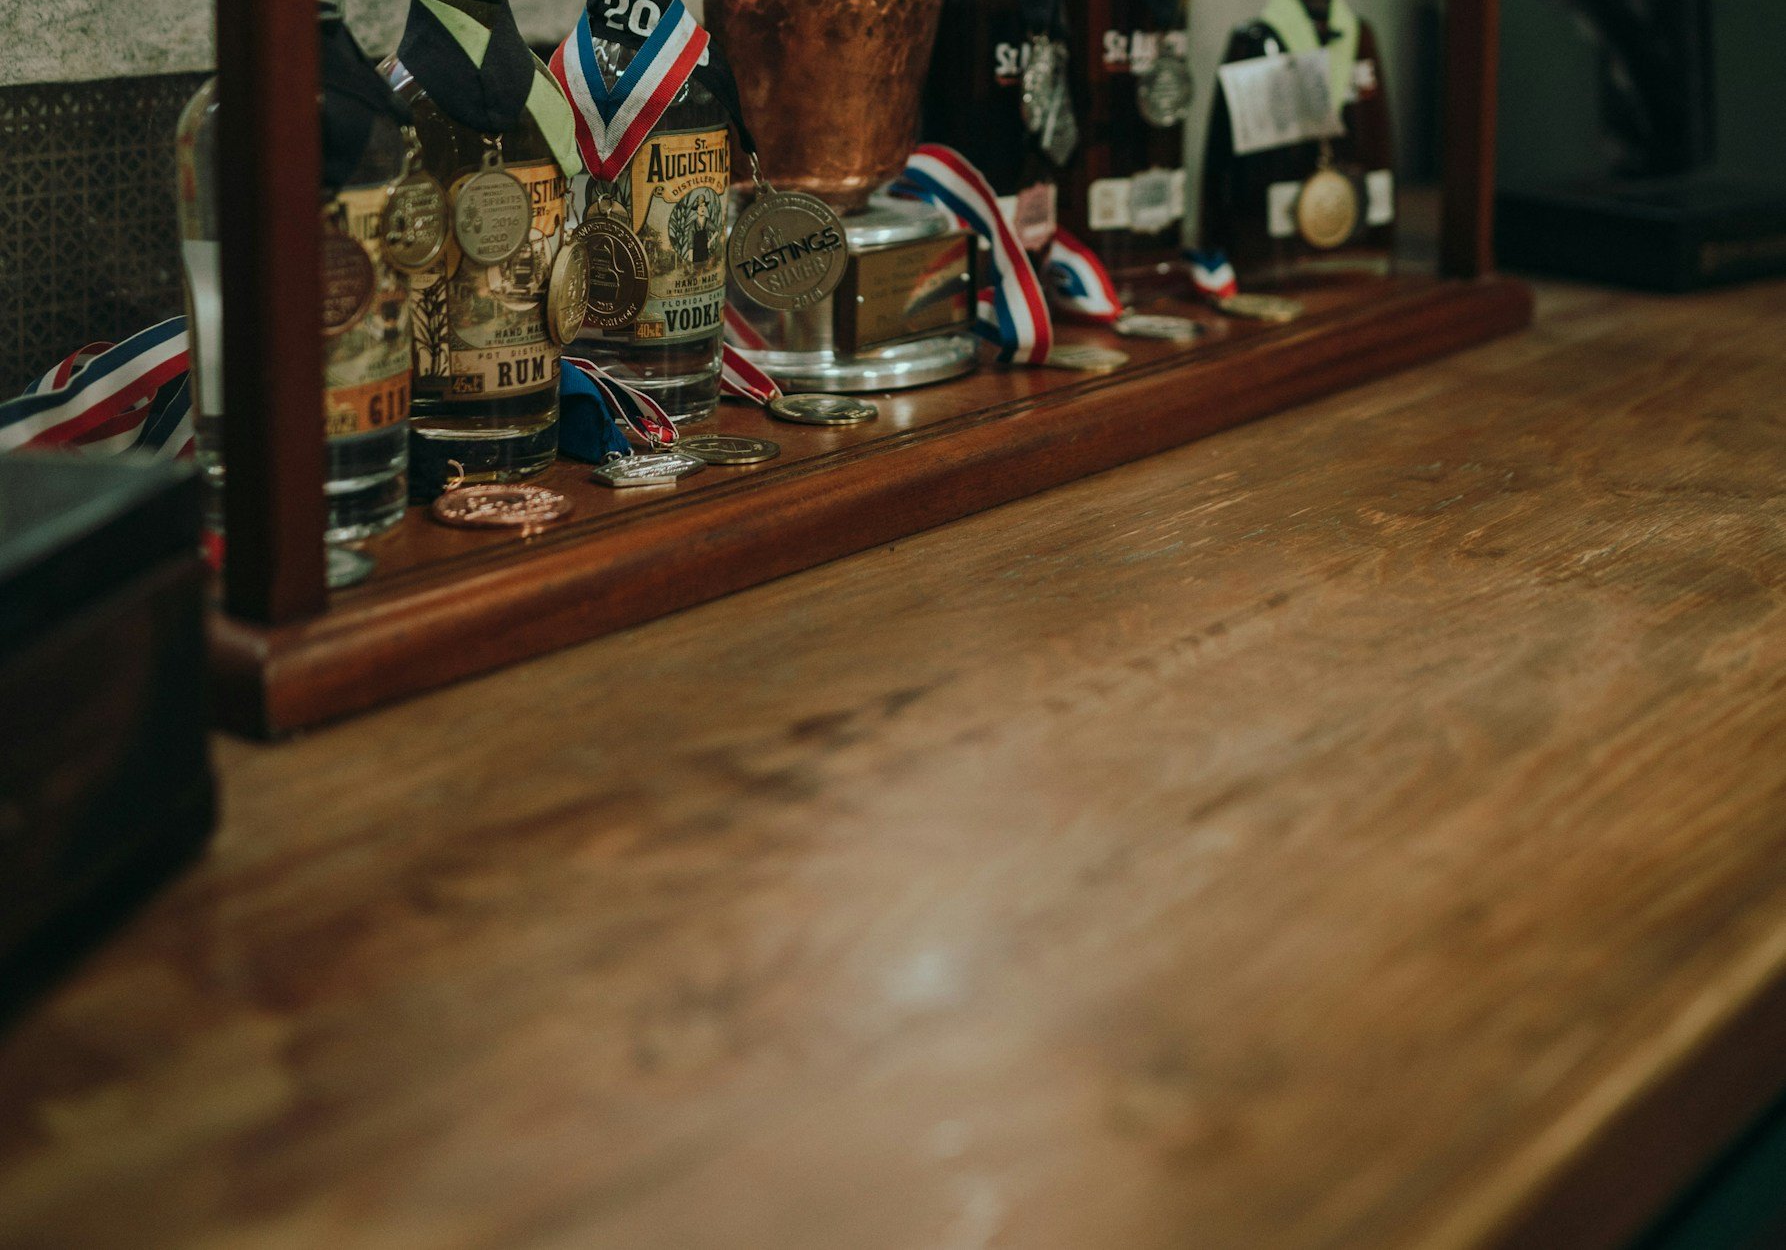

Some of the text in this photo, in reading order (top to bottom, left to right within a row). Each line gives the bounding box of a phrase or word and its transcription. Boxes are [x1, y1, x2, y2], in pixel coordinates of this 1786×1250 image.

[646, 135, 729, 183] AUGUSTINE
[672, 176, 716, 197] DISTILLERY
[481, 233, 509, 244] GOLD
[477, 244, 510, 255] MEDAL
[736, 226, 840, 280] TASTINGS
[675, 278, 698, 289] HAND
[702, 272, 718, 284] MADE
[662, 297, 703, 308] FLORIDA
[664, 301, 720, 333] VODKA
[495, 328, 522, 339] HAND
[478, 352, 500, 360] POT
[497, 355, 546, 388] RUM
